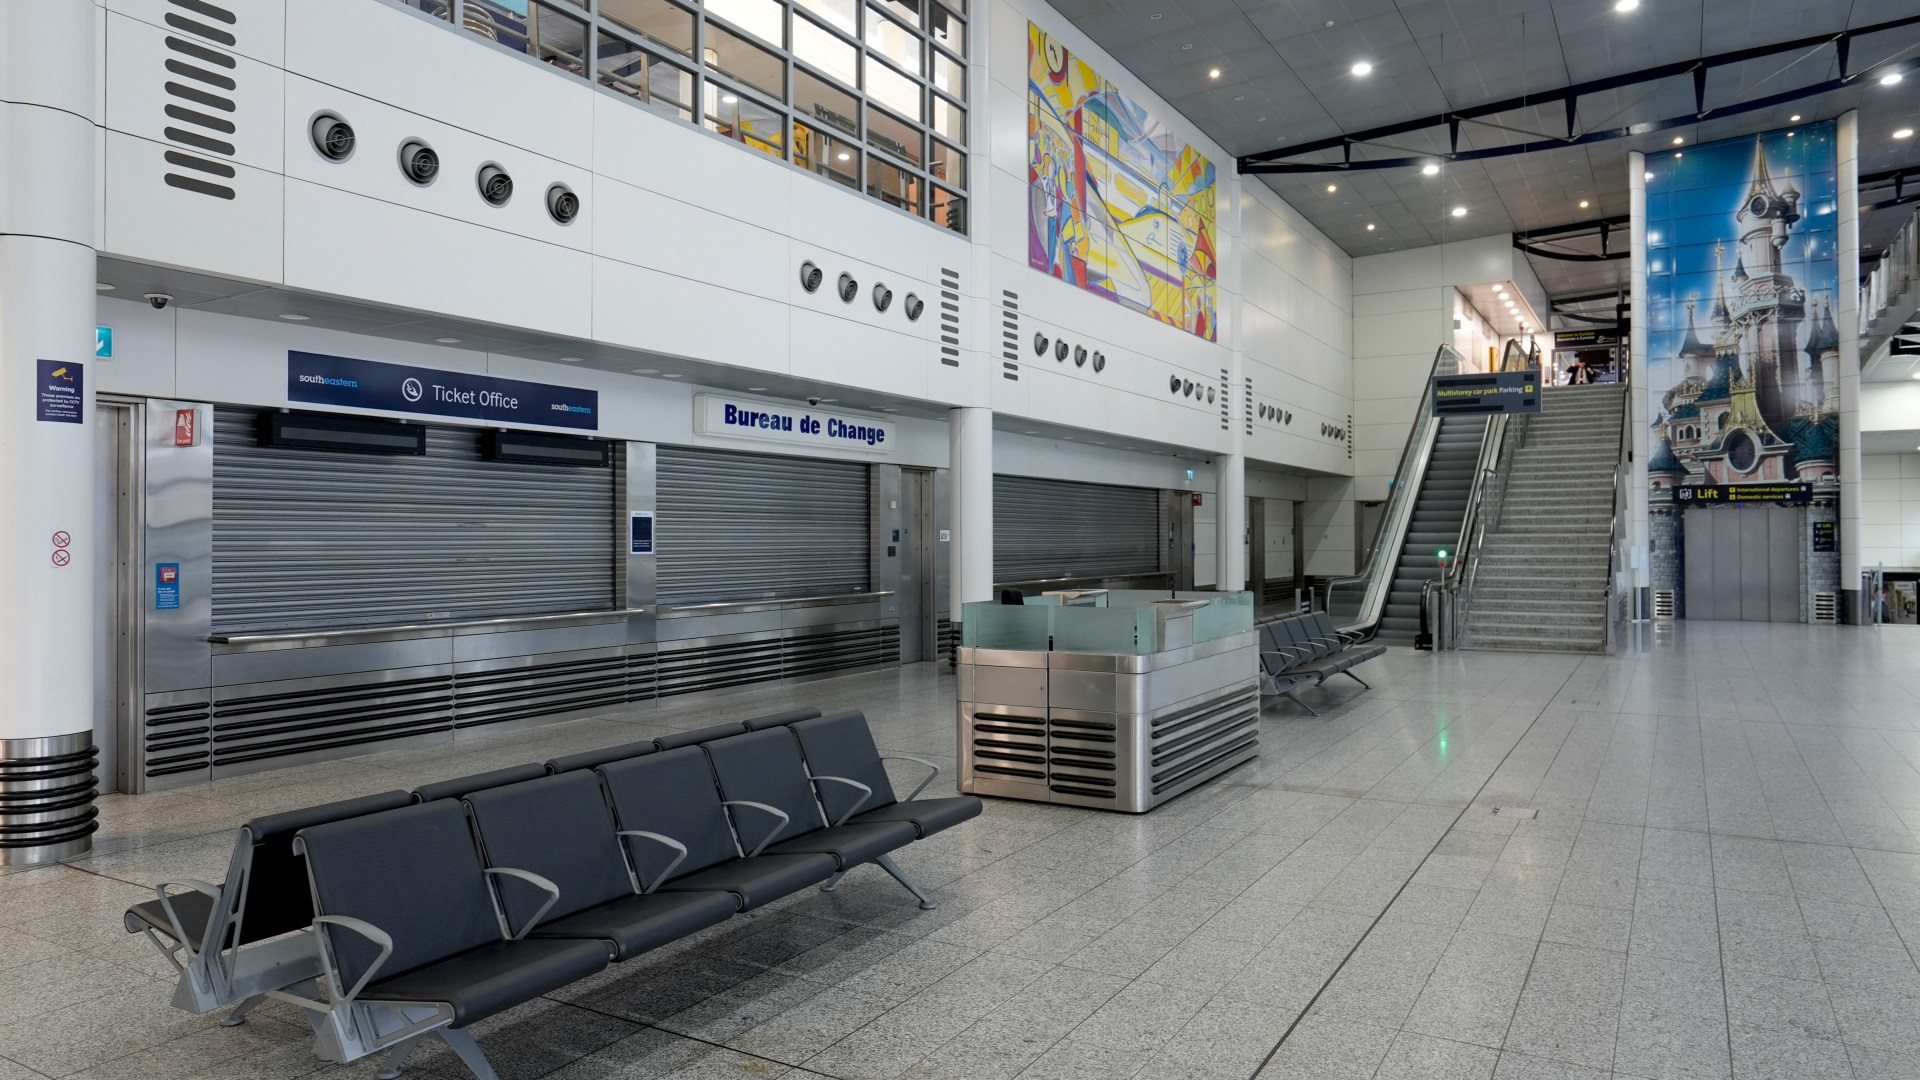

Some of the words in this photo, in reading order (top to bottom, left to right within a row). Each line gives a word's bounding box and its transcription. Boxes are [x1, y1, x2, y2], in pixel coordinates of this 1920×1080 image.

[300, 375, 358, 387] southeastern
[49, 385, 75, 393] Warning
[432, 384, 476, 405] Ticket
[479, 390, 518, 409] Office
[551, 403, 591, 414] southeastern
[725, 404, 792, 431] Bureau
[800, 415, 820, 434] de
[828, 418, 885, 445] Change
[1697, 489, 1718, 499] Lift
